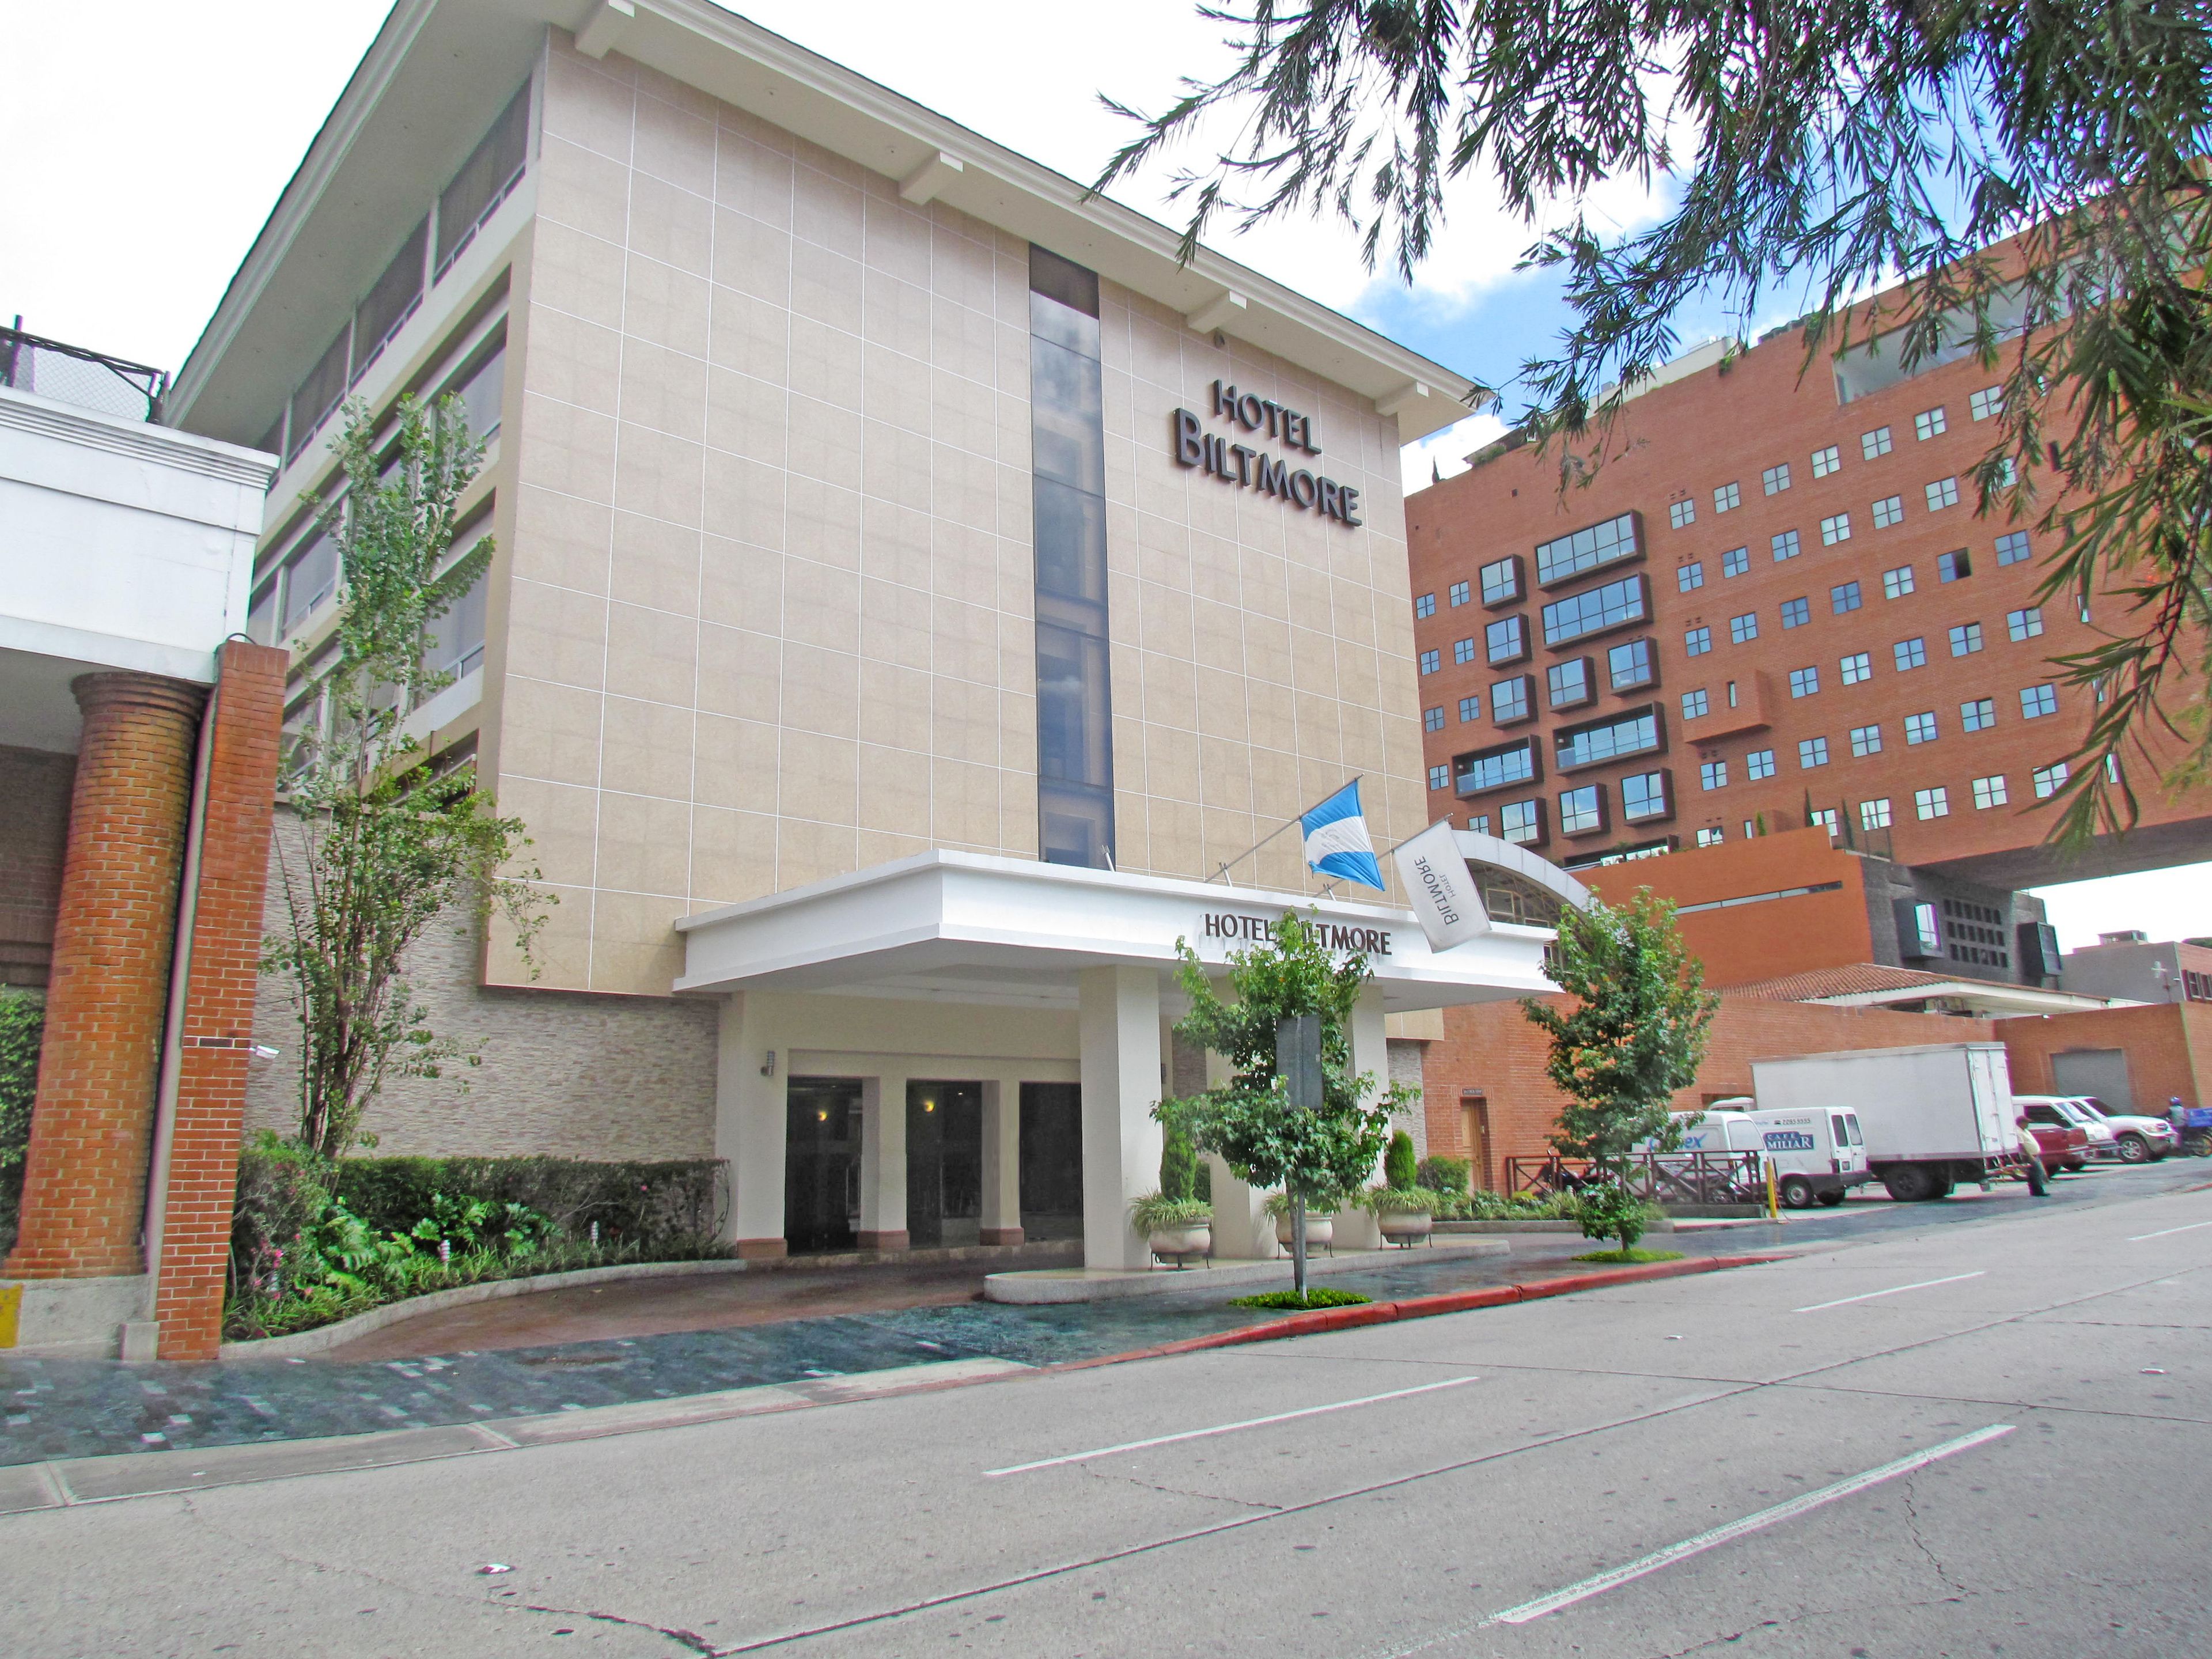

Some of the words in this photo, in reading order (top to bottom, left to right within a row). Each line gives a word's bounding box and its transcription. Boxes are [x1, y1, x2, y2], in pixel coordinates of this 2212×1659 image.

[1213, 379, 1321, 454] HOTEL
[1175, 408, 1362, 527] BILTMORE
[1205, 913, 1277, 942] HOTEL
[1285, 912, 1392, 955] ILTMORE
